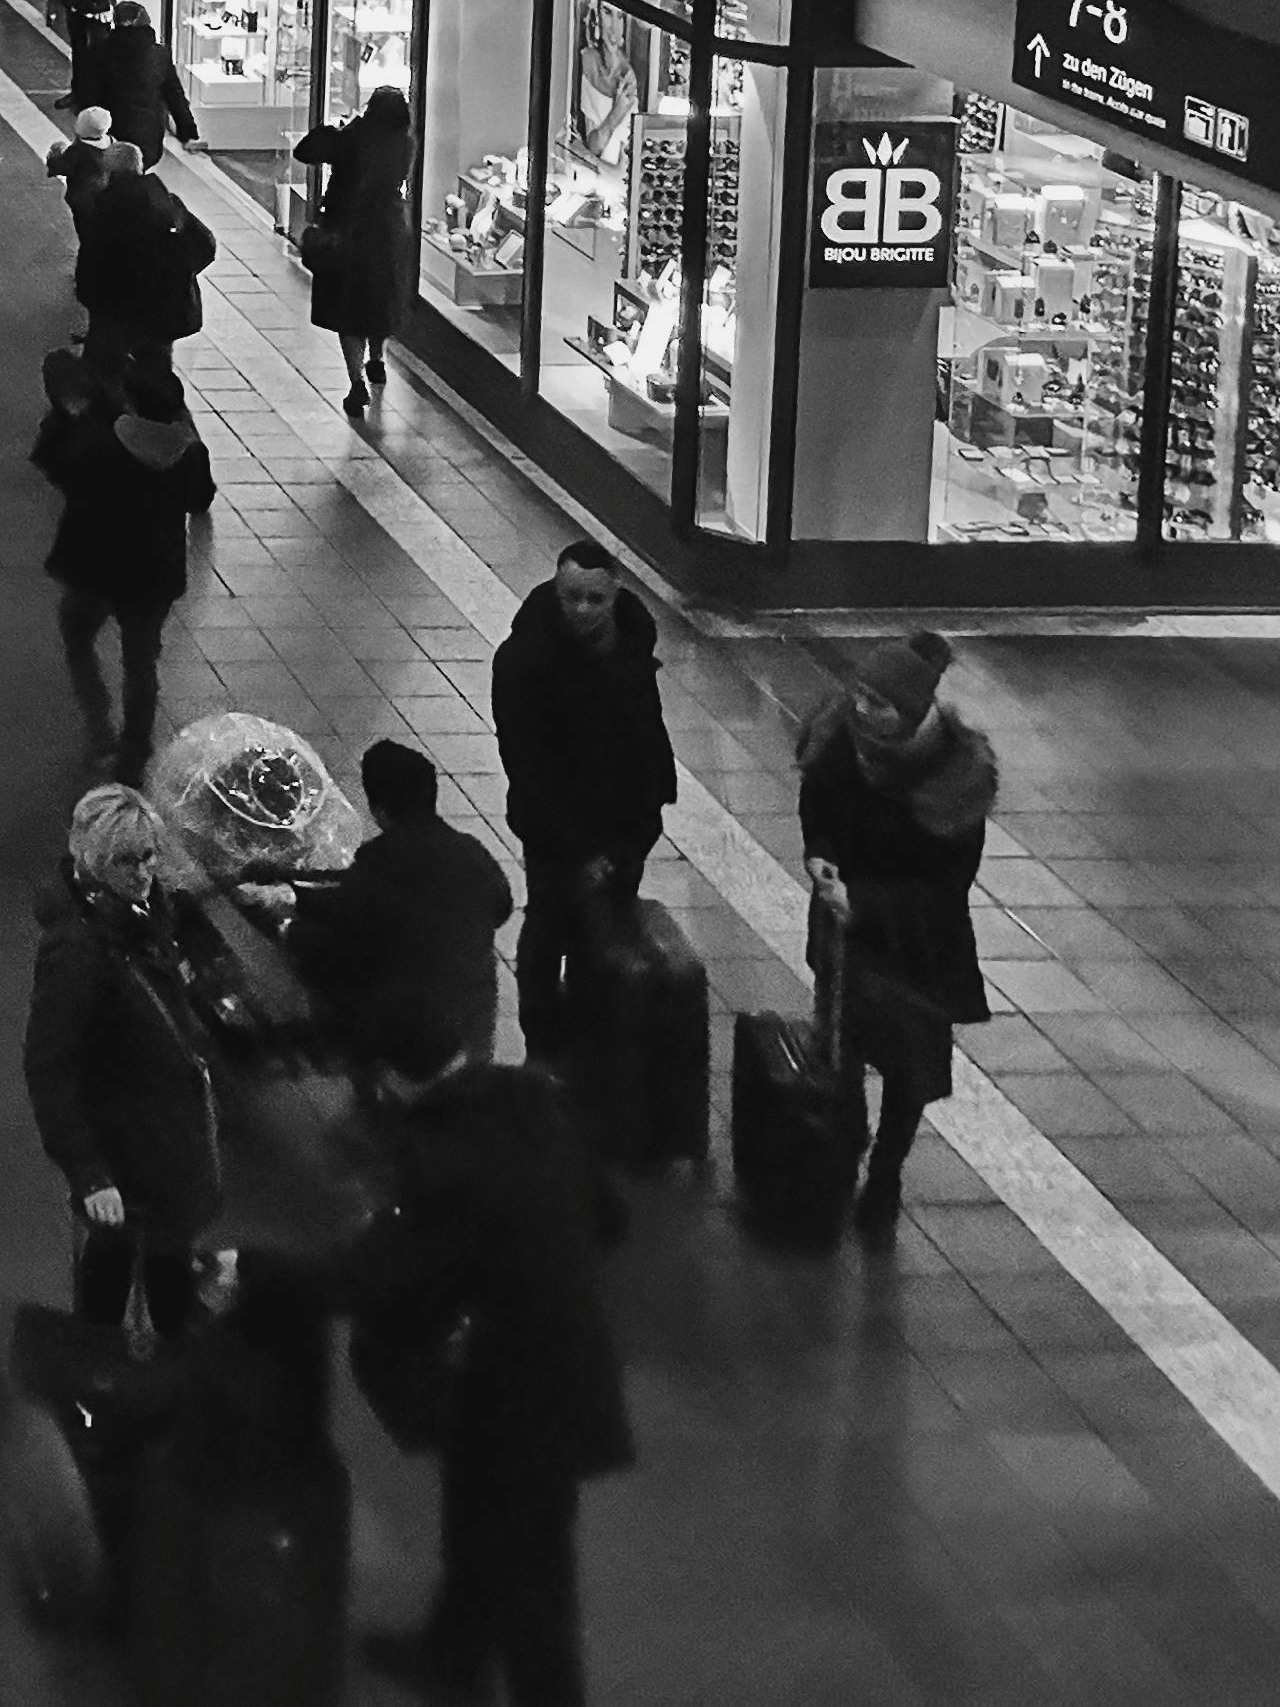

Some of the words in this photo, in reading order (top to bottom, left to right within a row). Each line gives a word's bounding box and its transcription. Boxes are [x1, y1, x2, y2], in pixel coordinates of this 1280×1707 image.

[1062, 52, 1080, 73] zu
[1081, 57, 1107, 83] den
[1108, 66, 1153, 102] Zügen
[823, 247, 867, 264] BIJOU
[870, 247, 935, 262] BRIGITTE
